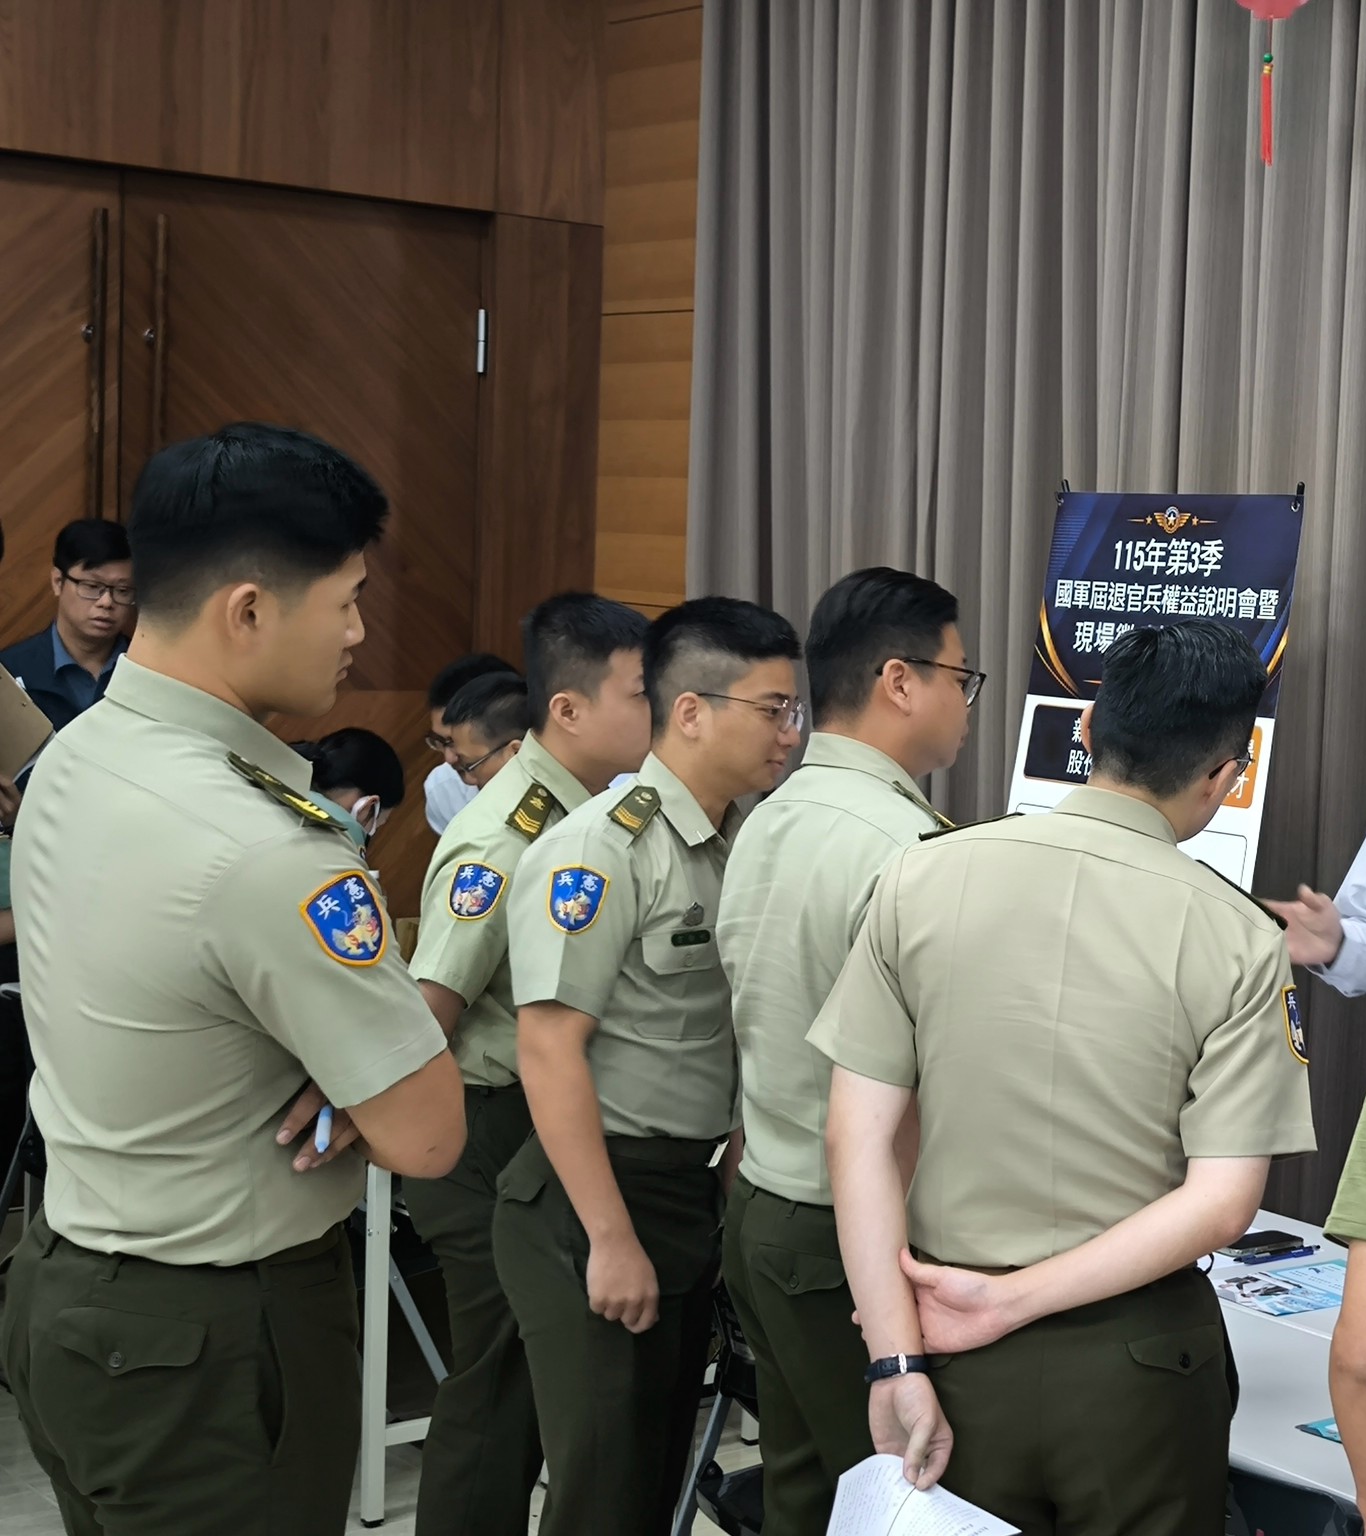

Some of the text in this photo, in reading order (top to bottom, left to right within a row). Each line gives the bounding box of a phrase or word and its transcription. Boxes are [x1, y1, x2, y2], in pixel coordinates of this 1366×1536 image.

[1114, 538, 1224, 578] 115年第3季
[1054, 578, 1280, 621] 國軍屆退官兵權益說明會暨
